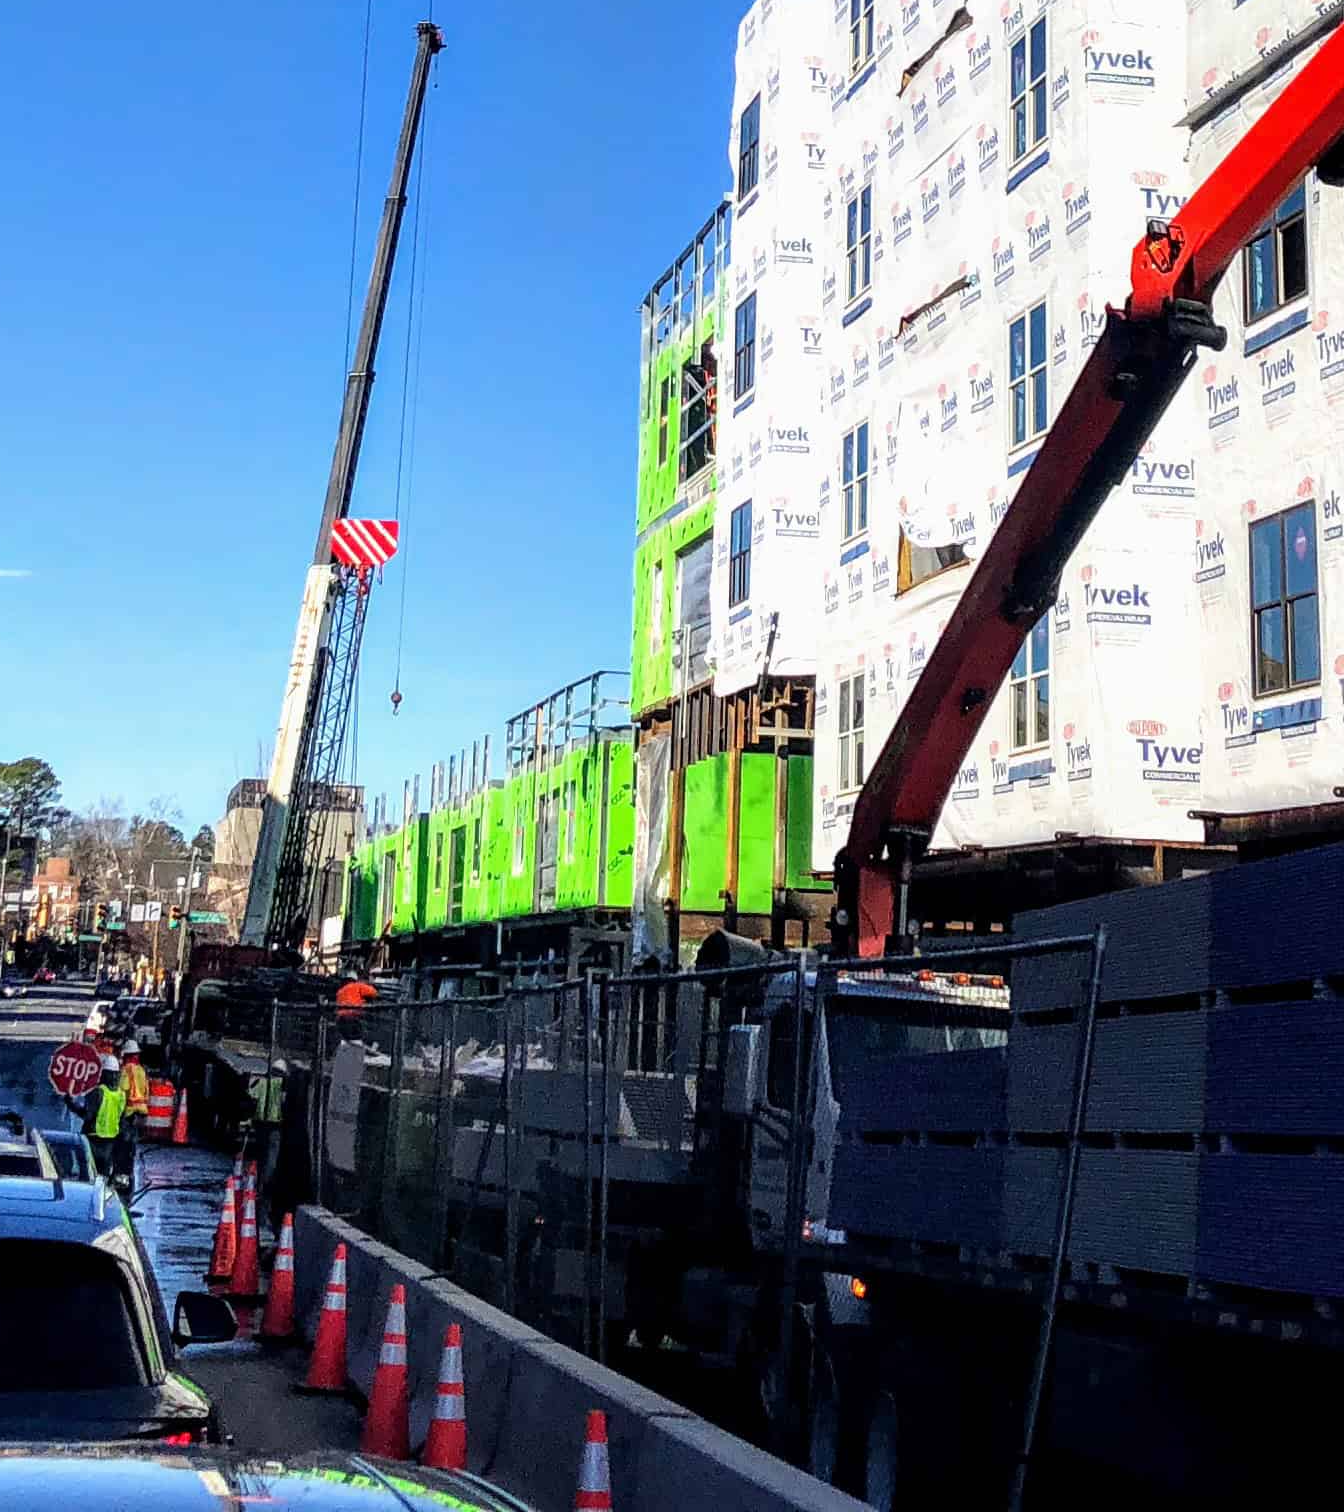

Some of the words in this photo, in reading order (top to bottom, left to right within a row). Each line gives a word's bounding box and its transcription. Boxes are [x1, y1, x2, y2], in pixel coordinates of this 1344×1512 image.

[1139, 188, 1187, 215] Tyv
[1259, 349, 1295, 384] Tyvek
[1206, 376, 1239, 411] Tyvek
[1221, 703, 1248, 731] Tyve
[1137, 739, 1201, 766] Tyve
[53, 1056, 98, 1082] STOP
